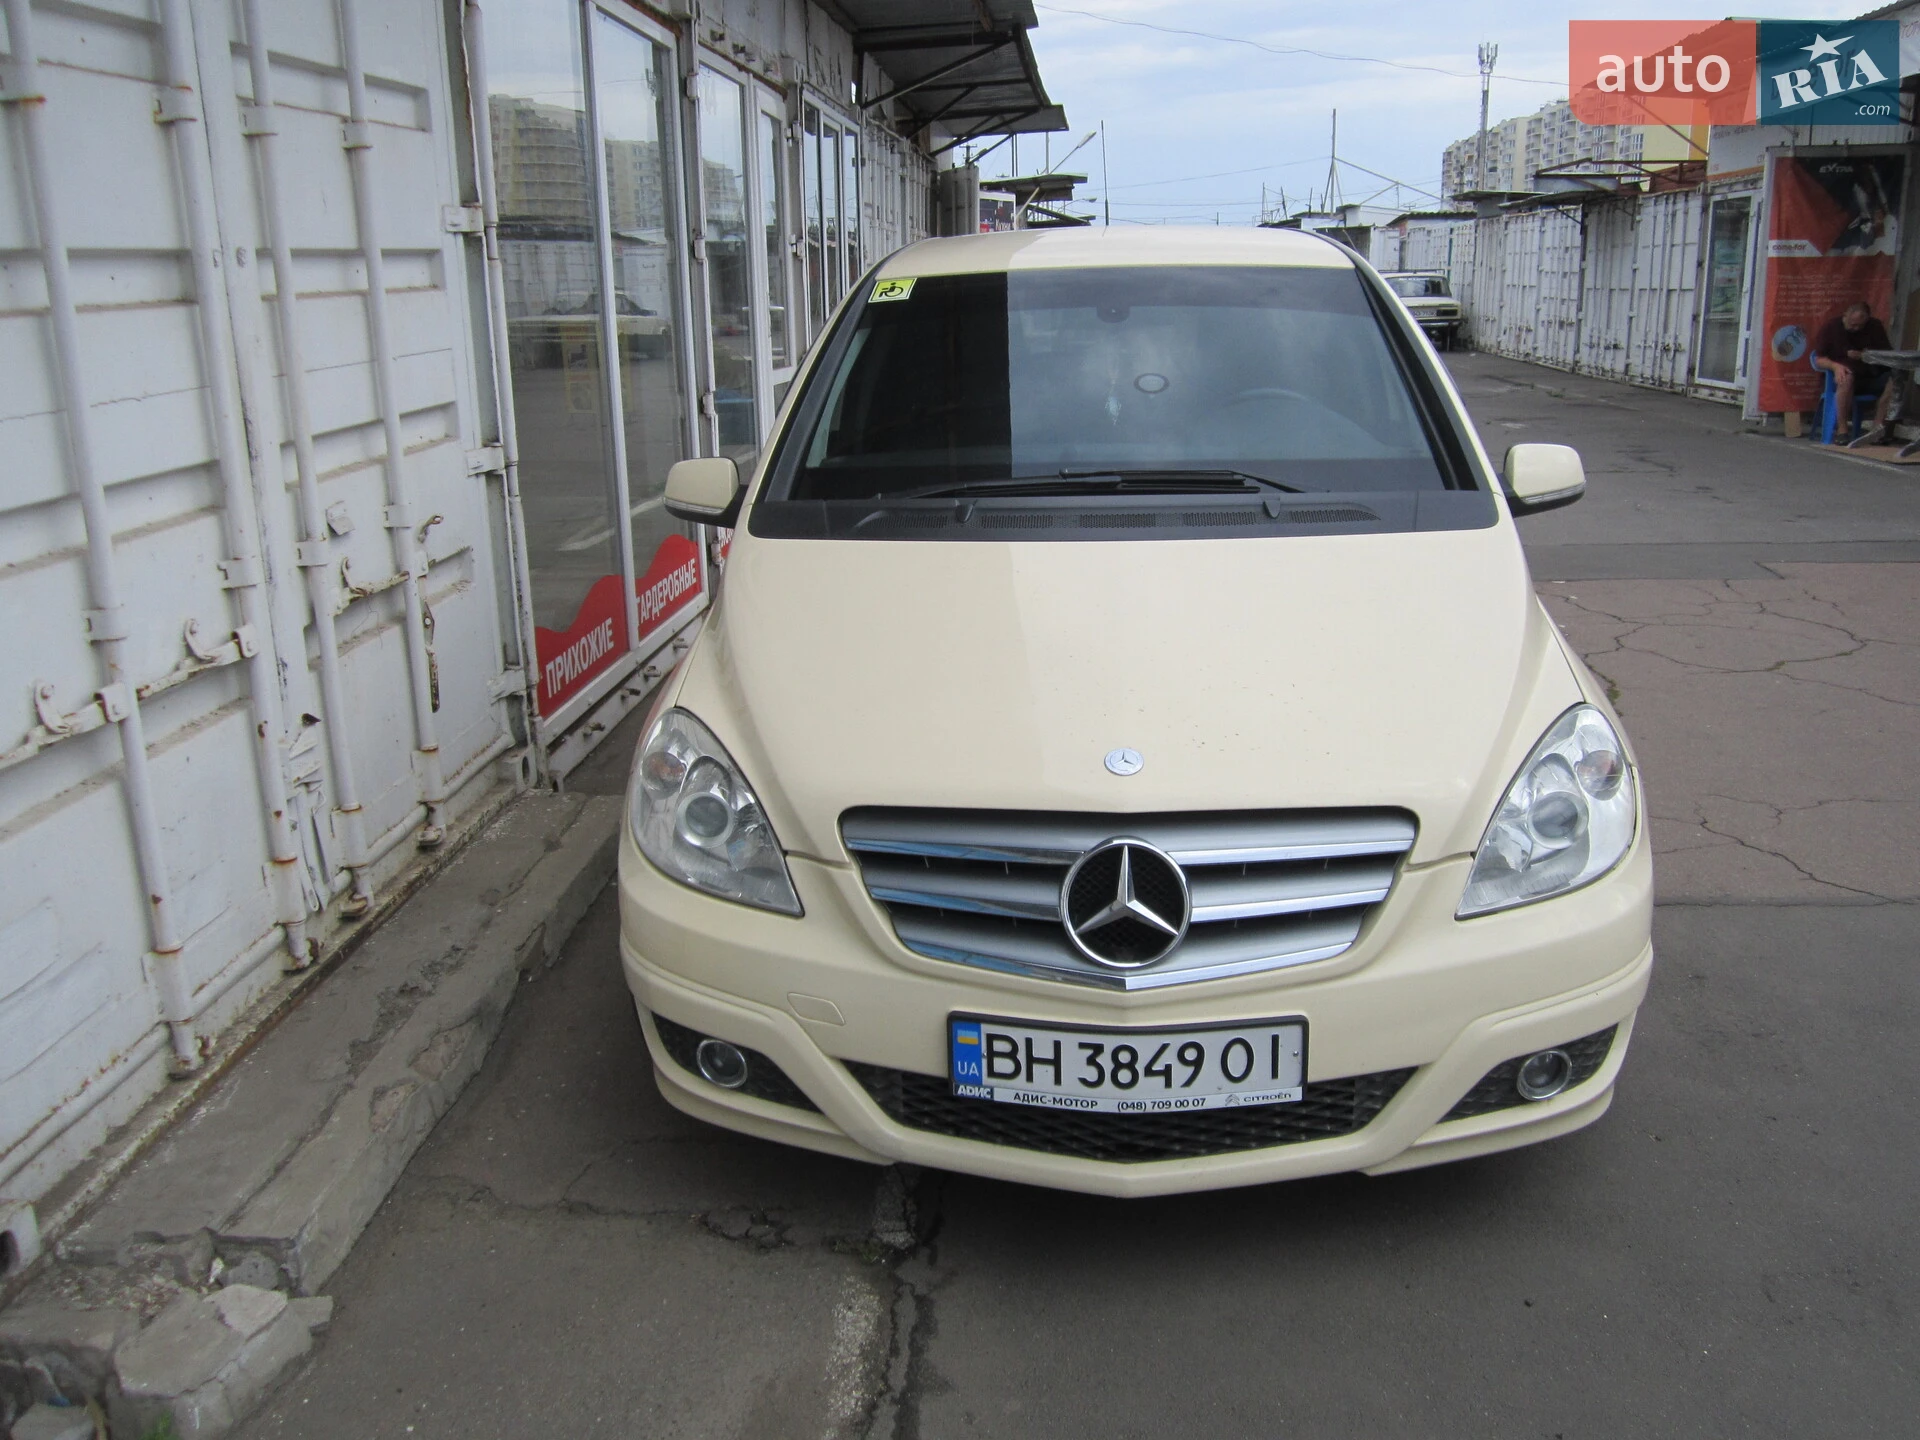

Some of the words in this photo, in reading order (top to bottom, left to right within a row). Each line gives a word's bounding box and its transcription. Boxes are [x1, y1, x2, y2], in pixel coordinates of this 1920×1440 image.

[545, 617, 614, 698] ПРИХОЖИЕ
[957, 1061, 980, 1078] UA
[986, 1033, 1062, 1086] BH
[1078, 1041, 1206, 1090] 3849
[1013, 1092, 1098, 1109] АДИС-МОТОР
[1117, 1101, 1147, 1112] (048)
[1150, 1100, 1172, 1110] 709
[1175, 1099, 1190, 1109] 00
[1192, 1098, 1207, 1107] 07
